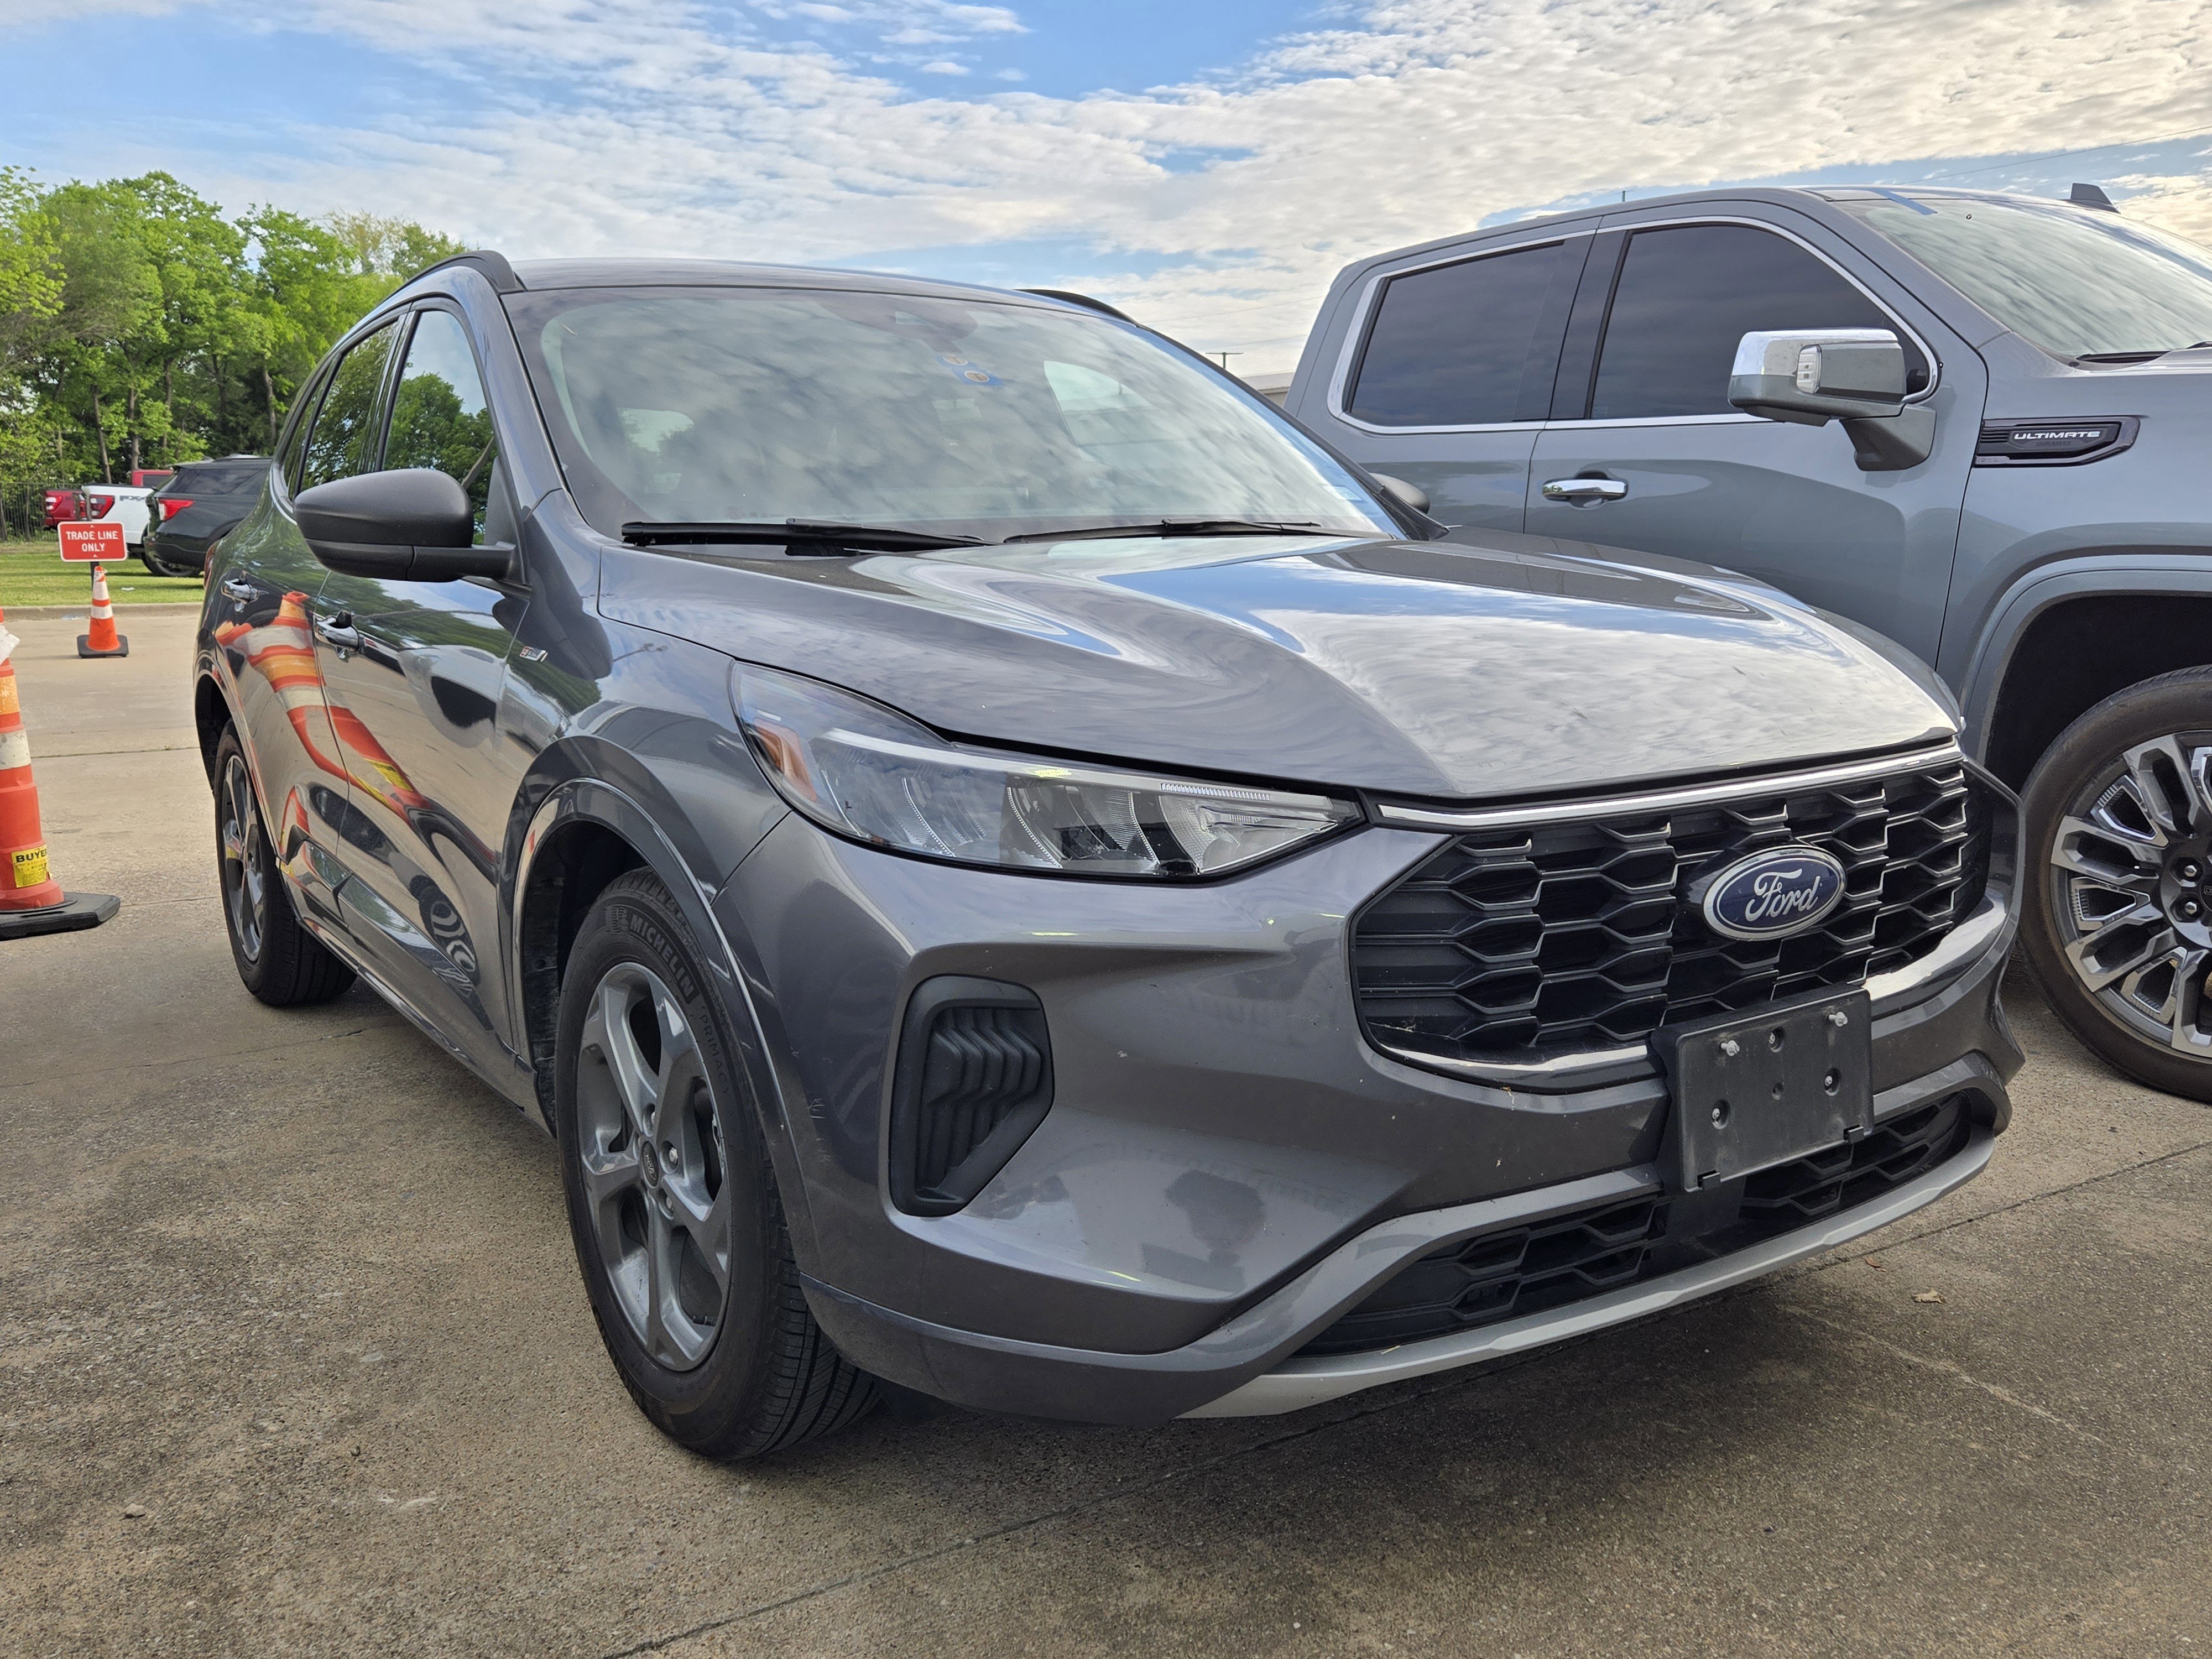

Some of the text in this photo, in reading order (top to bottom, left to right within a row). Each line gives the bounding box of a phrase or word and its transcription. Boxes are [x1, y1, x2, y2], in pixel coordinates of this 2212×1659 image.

[2014, 431, 2100, 440] ULTIMATE
[66, 531, 119, 540] TRADE LINE
[81, 542, 106, 552] ONLY
[1745, 868, 1821, 922] Ford
[630, 914, 695, 997] MICHELIN
[699, 1014, 730, 1094] PRIMACY
